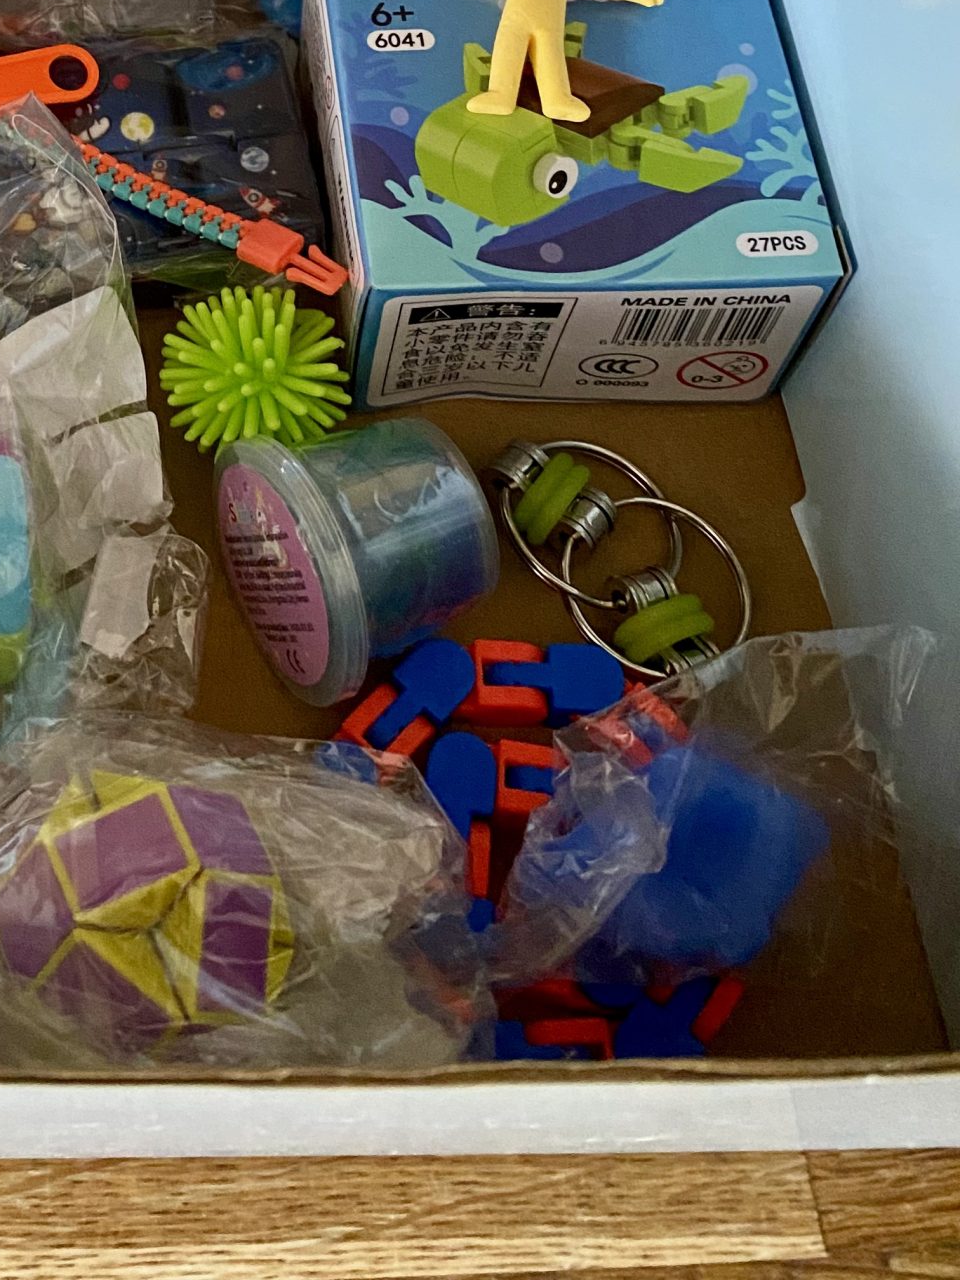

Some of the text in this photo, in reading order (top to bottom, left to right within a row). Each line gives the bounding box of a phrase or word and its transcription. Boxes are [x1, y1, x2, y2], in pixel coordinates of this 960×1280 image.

[371, 2, 414, 27] 6+
[374, 32, 426, 49] 6041
[746, 235, 807, 253] 27PCS
[620, 294, 792, 307] MADE IN CHINA
[691, 375, 724, 383] 0-3
